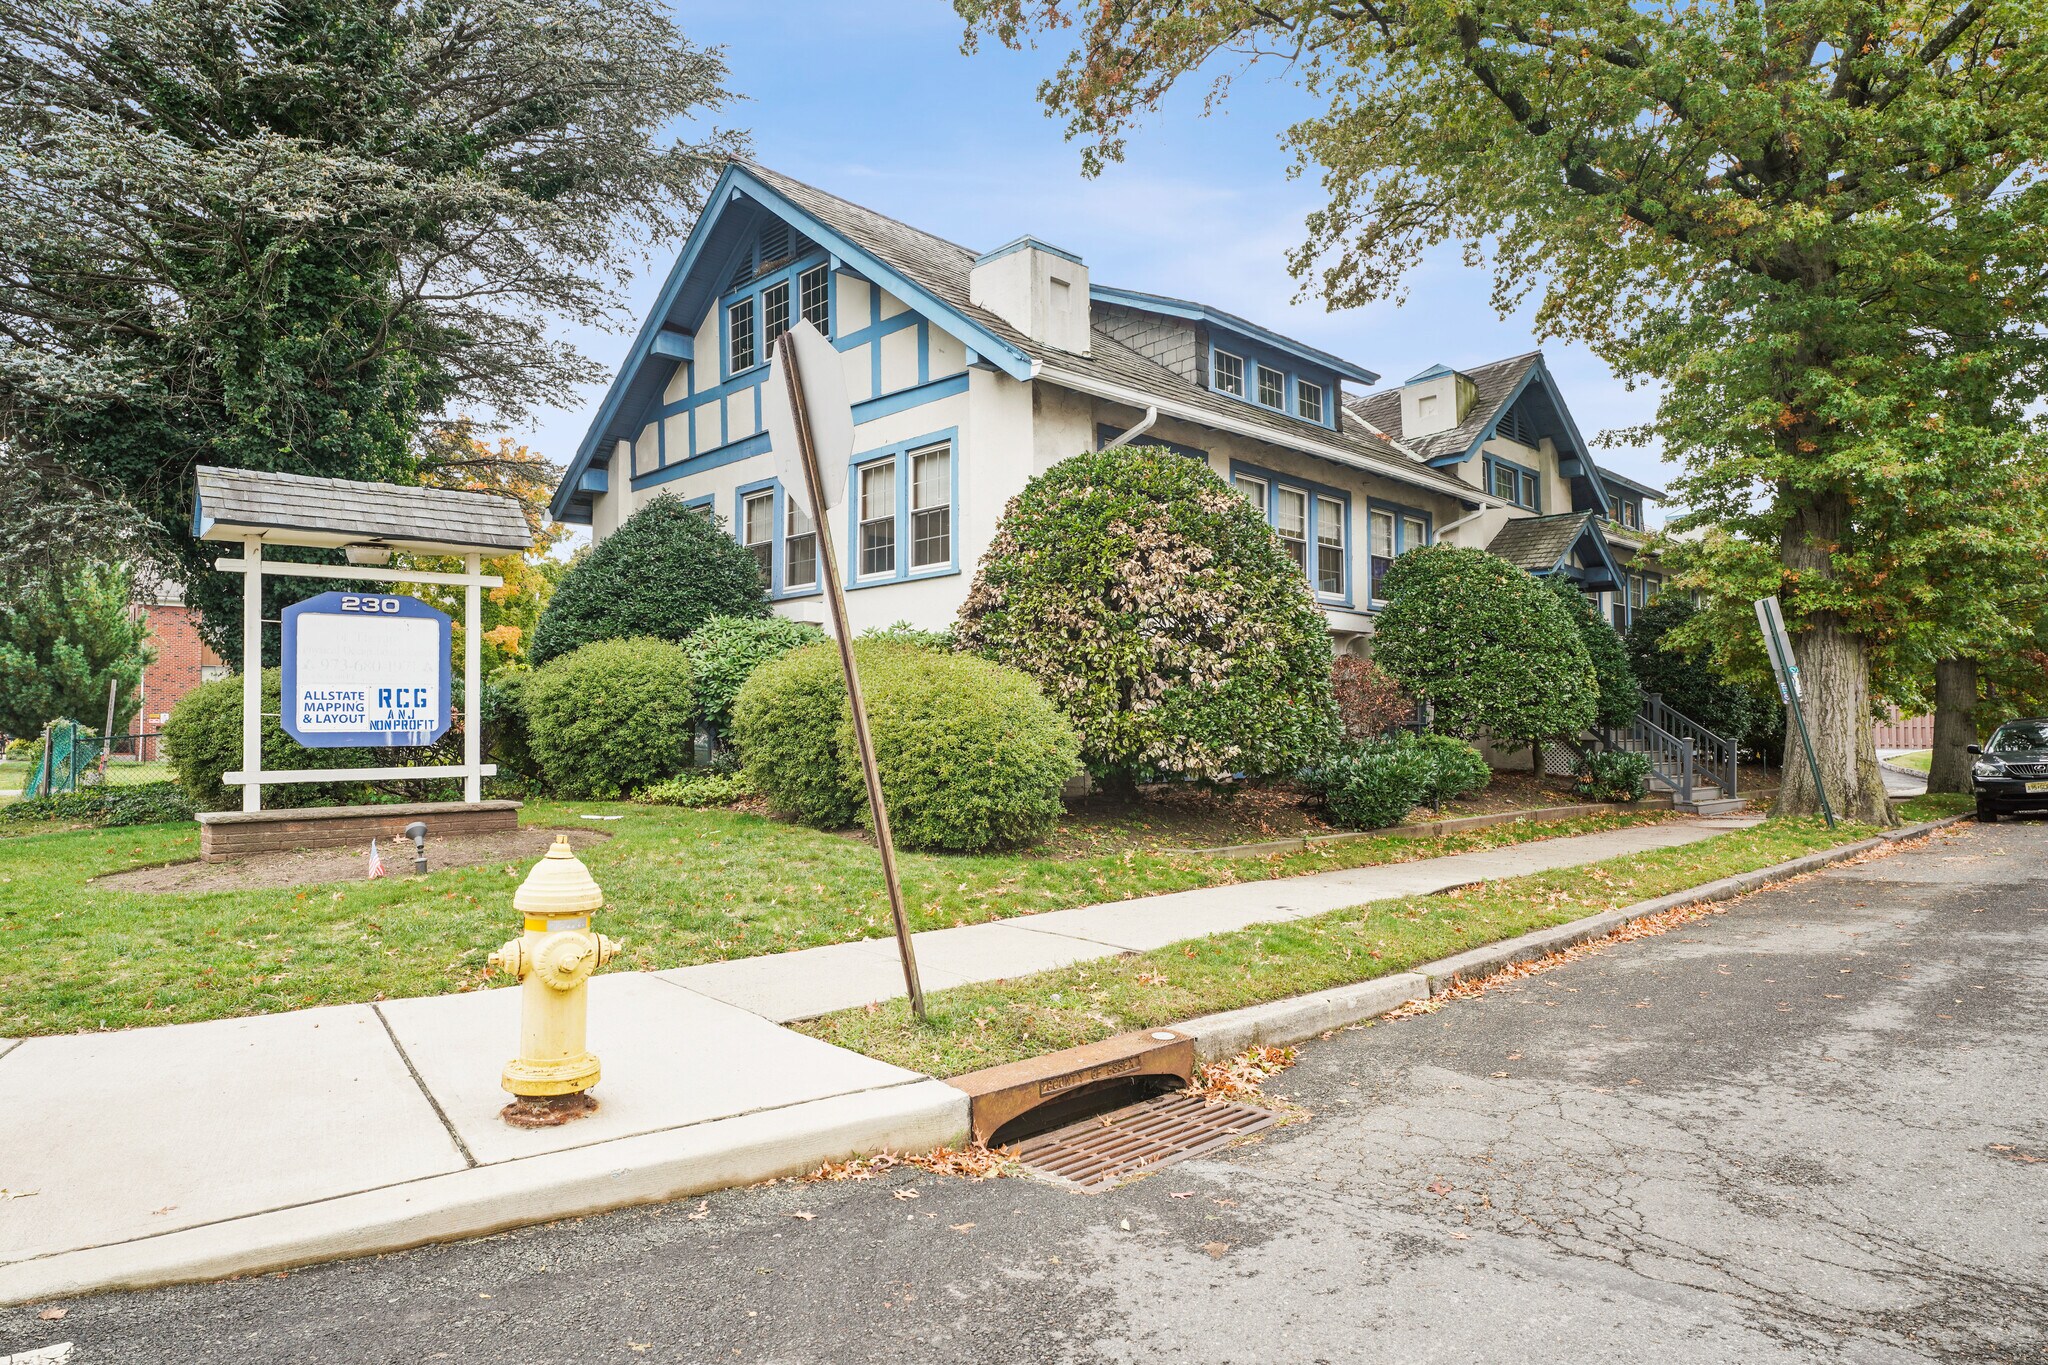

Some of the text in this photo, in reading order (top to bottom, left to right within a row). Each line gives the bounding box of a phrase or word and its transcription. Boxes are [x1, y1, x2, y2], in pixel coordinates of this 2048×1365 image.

[341, 596, 400, 613] 230
[304, 690, 365, 701] ALLSTATE
[378, 688, 427, 708] RCG
[304, 702, 365, 712] MAPPING
[302, 714, 365, 723] & LAYOUT
